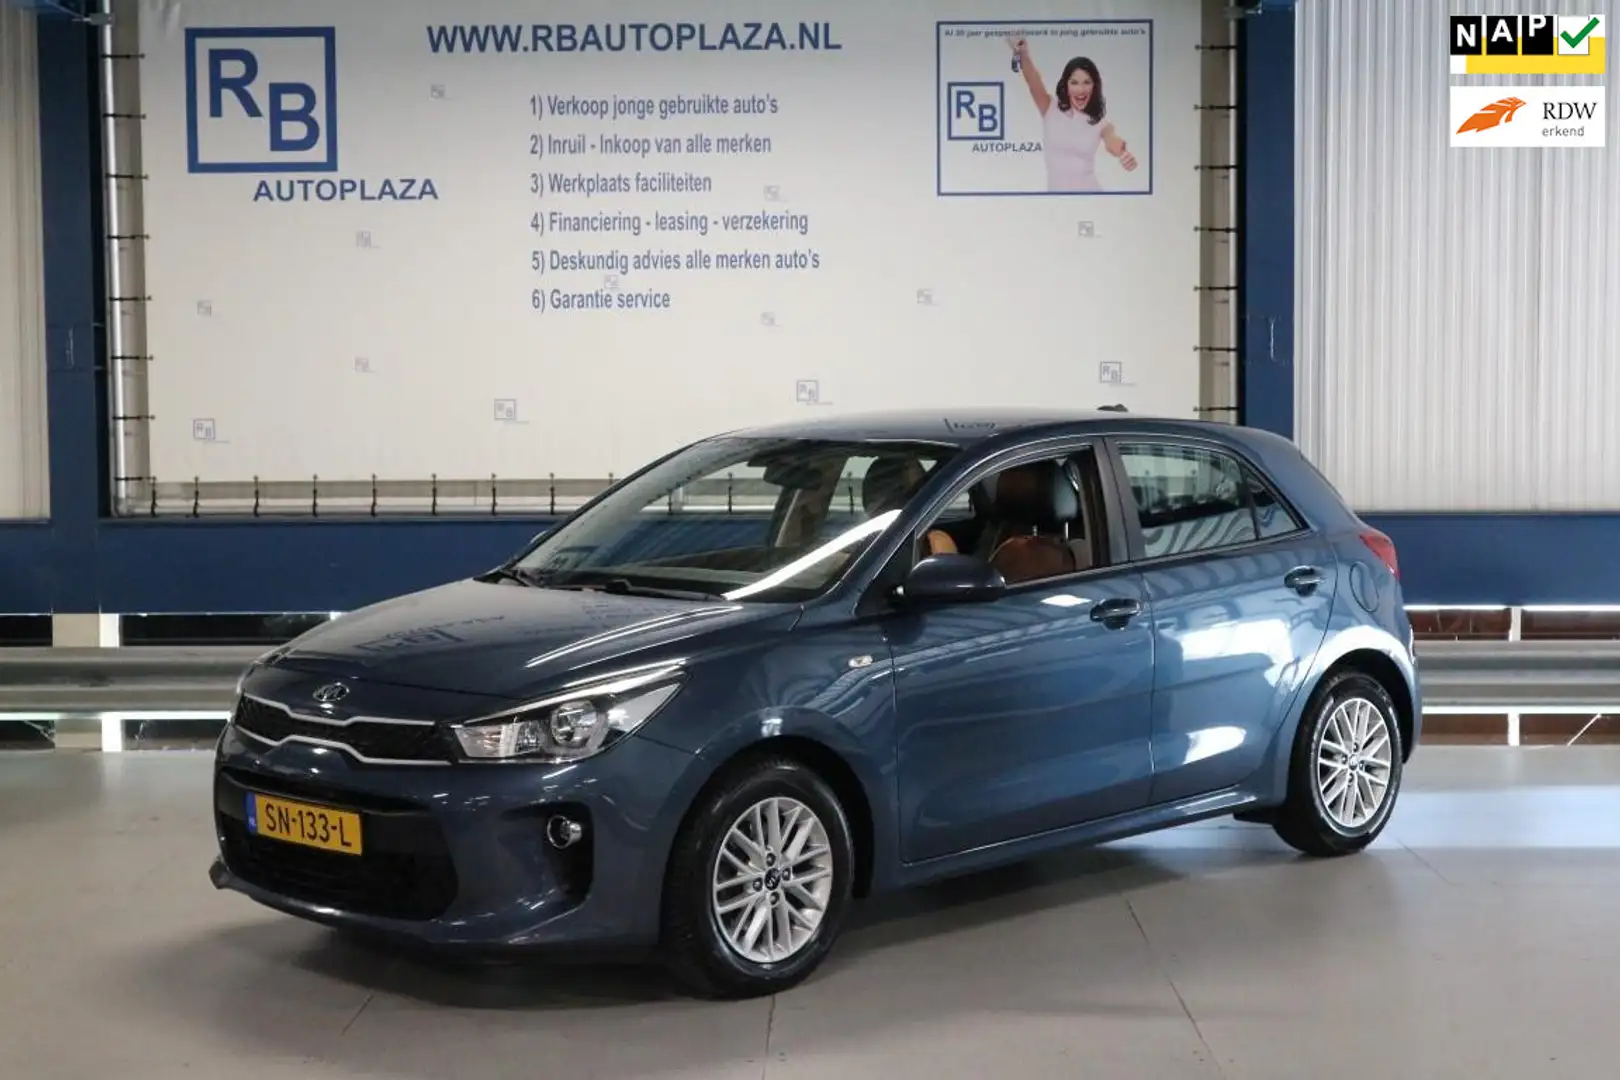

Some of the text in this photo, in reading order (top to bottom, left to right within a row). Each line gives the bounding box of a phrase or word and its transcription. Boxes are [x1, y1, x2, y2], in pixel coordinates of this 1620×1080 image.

[427, 22, 842, 53] WWW.RBAUTOPLAZA.NL
[530, 93, 779, 121] 1) Verkoop jonge gebruikte auto's
[530, 134, 543, 159] 2)
[549, 133, 586, 155] Inruil
[600, 133, 651, 159] Inkoop
[655, 138, 682, 154] van
[686, 133, 712, 154] alle
[716, 133, 771, 154] merken
[972, 141, 1042, 153] AUTOPLAZA
[253, 178, 439, 202] AUTOPLAZA
[531, 171, 712, 197] 3) Werkplaats faciliteiten
[531, 212, 544, 236] 4)
[549, 211, 641, 237] Financiering
[655, 210, 708, 236] leasing
[722, 209, 808, 235] verzekering
[532, 248, 820, 275] 5) Deskundig advies alle merken auto's
[532, 288, 670, 313] 6) Garantie service
[264, 803, 352, 847] SN-133-L
